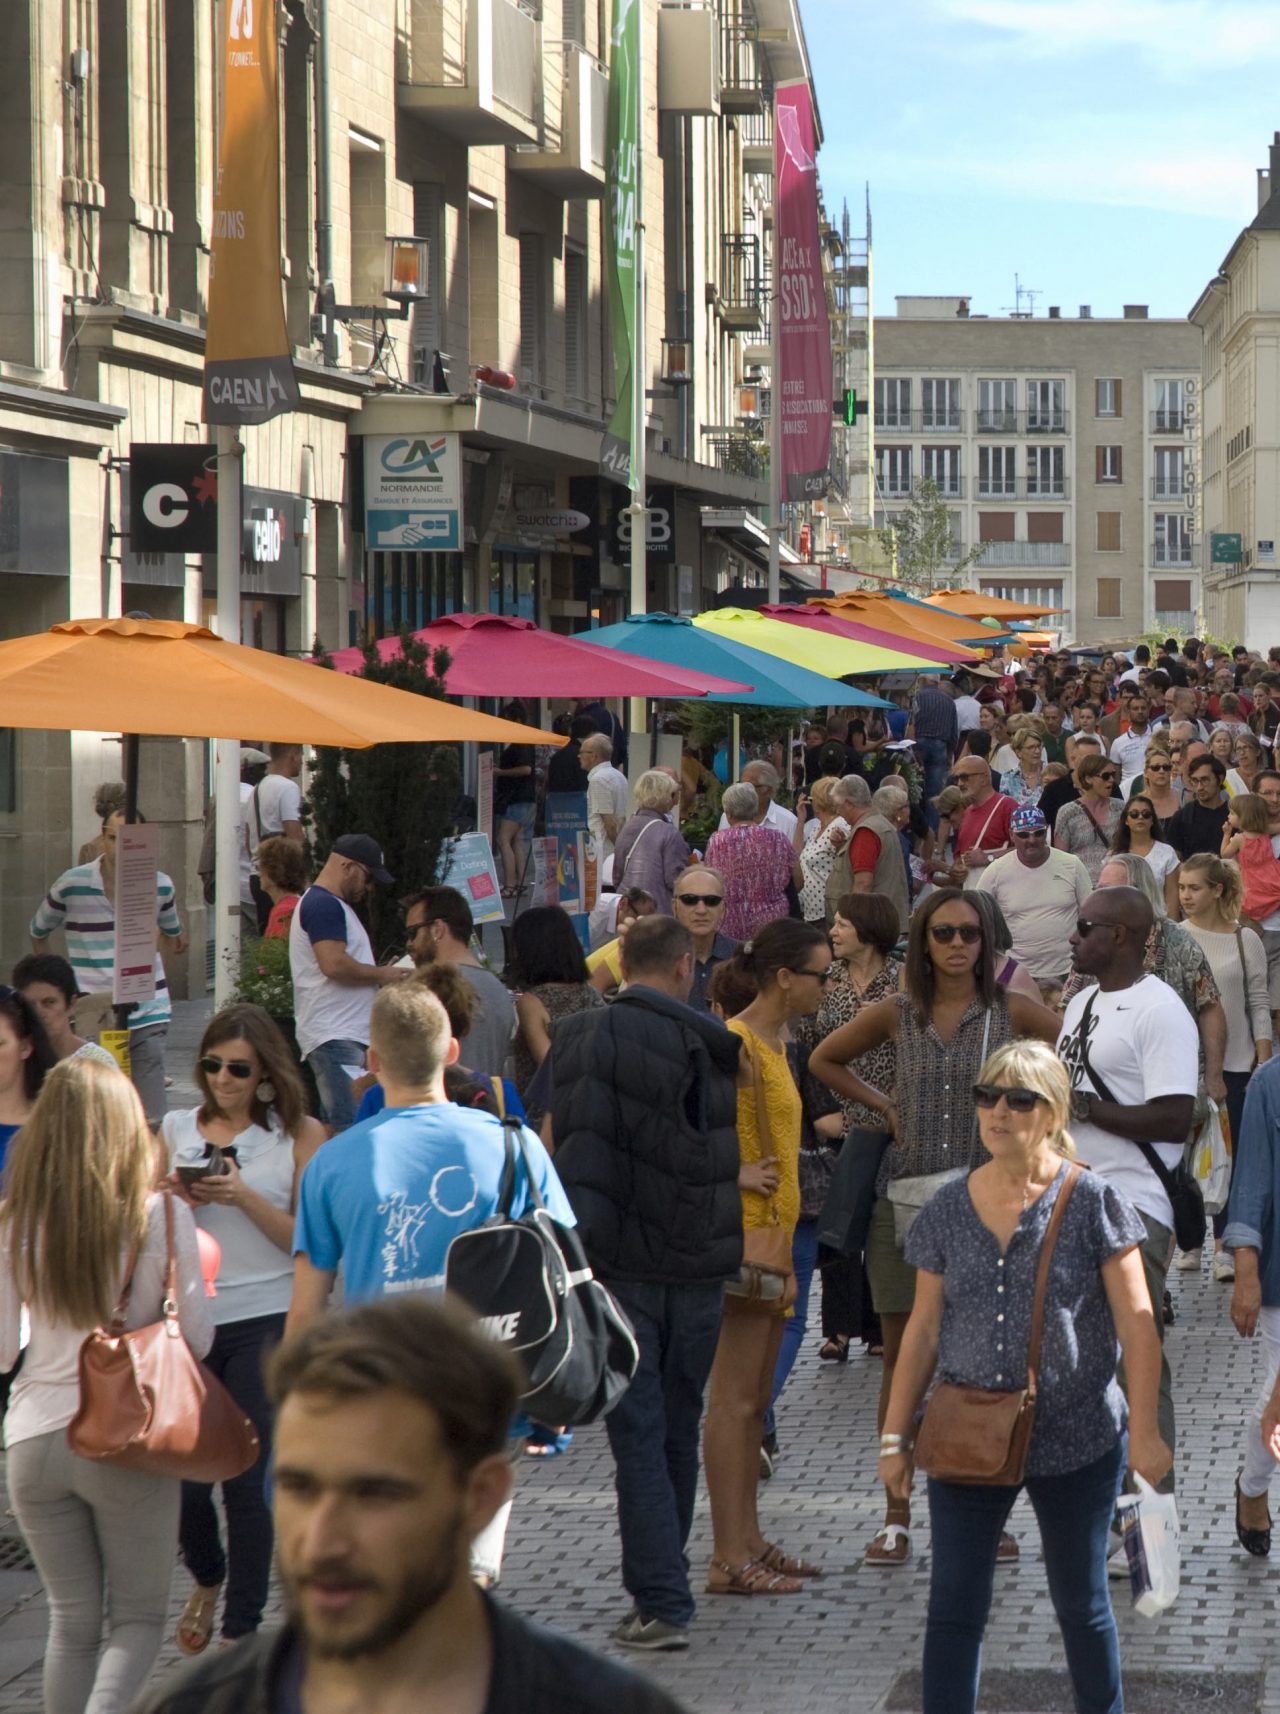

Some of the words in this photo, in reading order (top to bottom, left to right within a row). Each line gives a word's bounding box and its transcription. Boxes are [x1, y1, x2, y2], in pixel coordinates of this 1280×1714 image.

[210, 375, 264, 404] CAEN
[1186, 379, 1196, 533] OPTIQUE
[380, 484, 444, 493] NORMANDIE
[254, 506, 281, 562] celio
[516, 514, 568, 527] swatch
